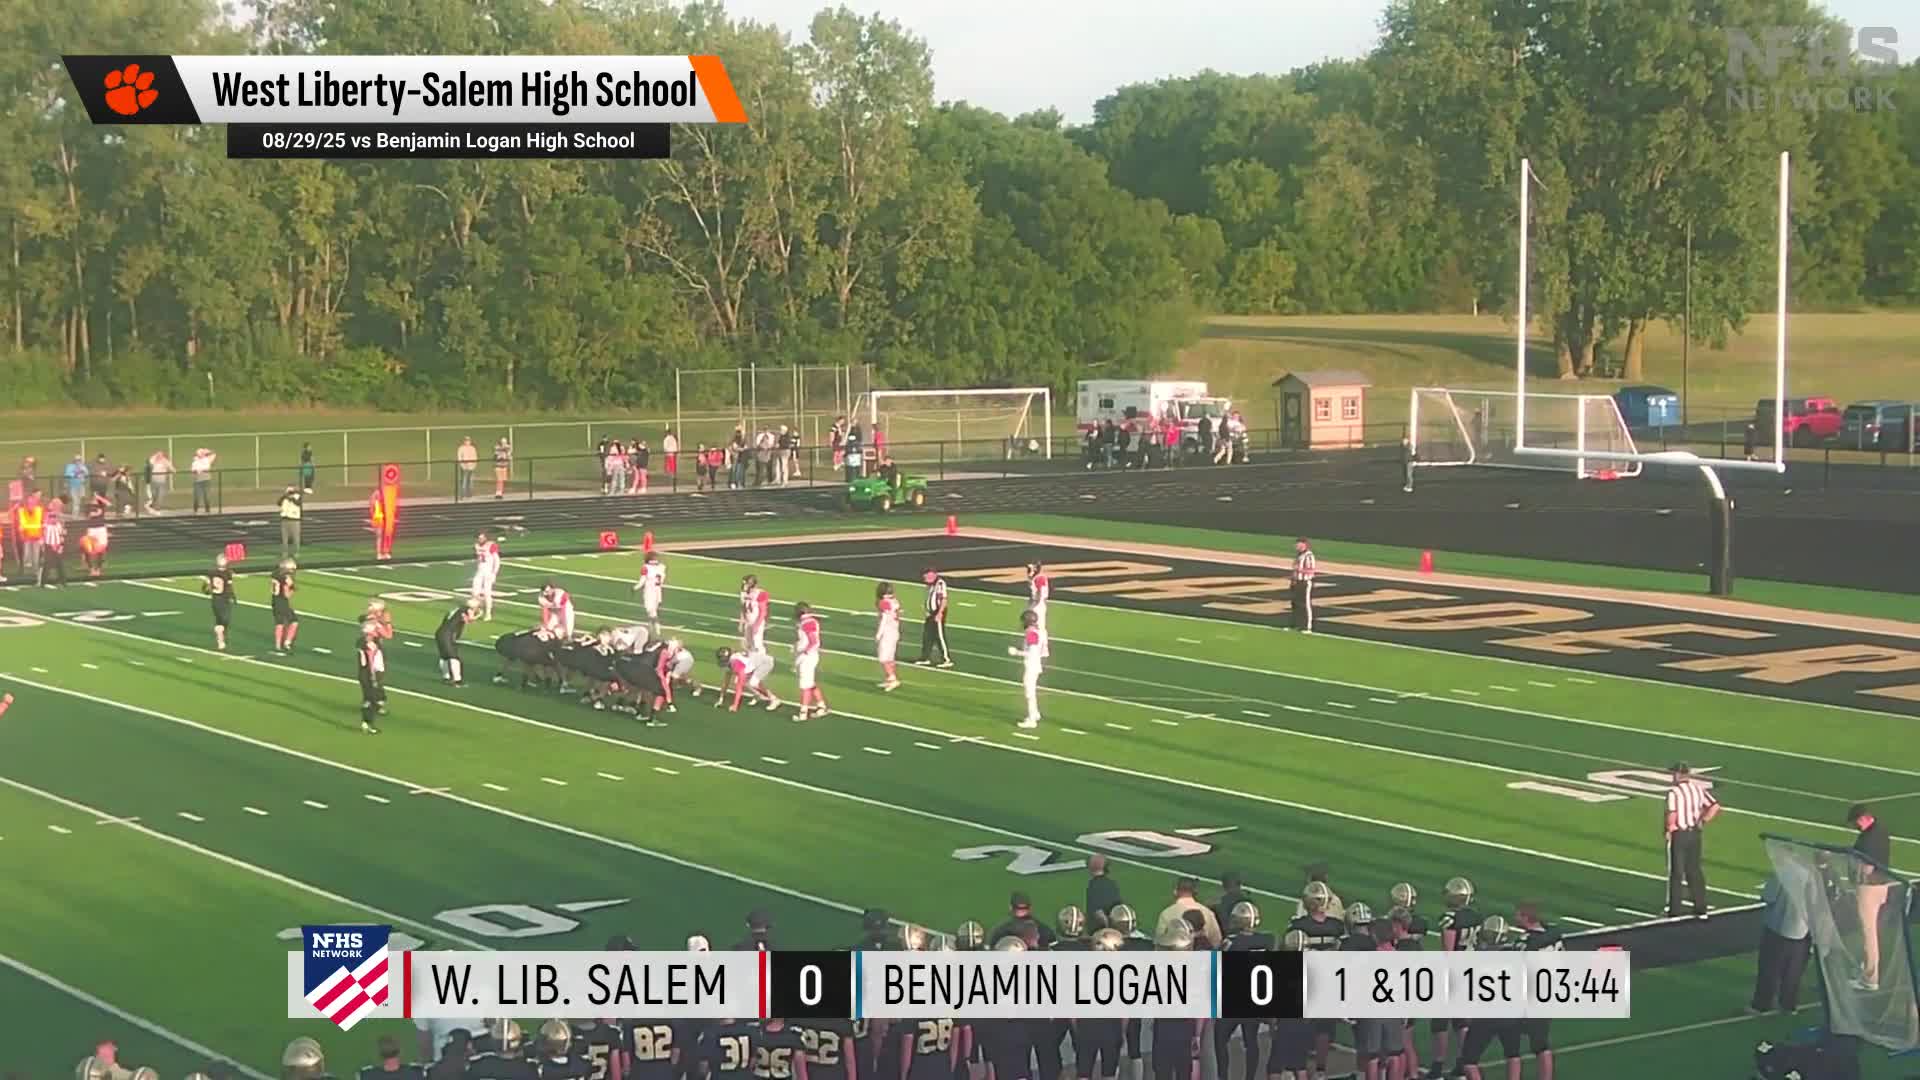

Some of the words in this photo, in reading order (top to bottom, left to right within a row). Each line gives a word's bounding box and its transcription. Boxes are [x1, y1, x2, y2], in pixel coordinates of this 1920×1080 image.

[930, 560, 1920, 701] RAIDER
[952, 830, 1212, 875] 20
[633, 1025, 673, 1060] 82
[719, 1035, 750, 1071] 31
